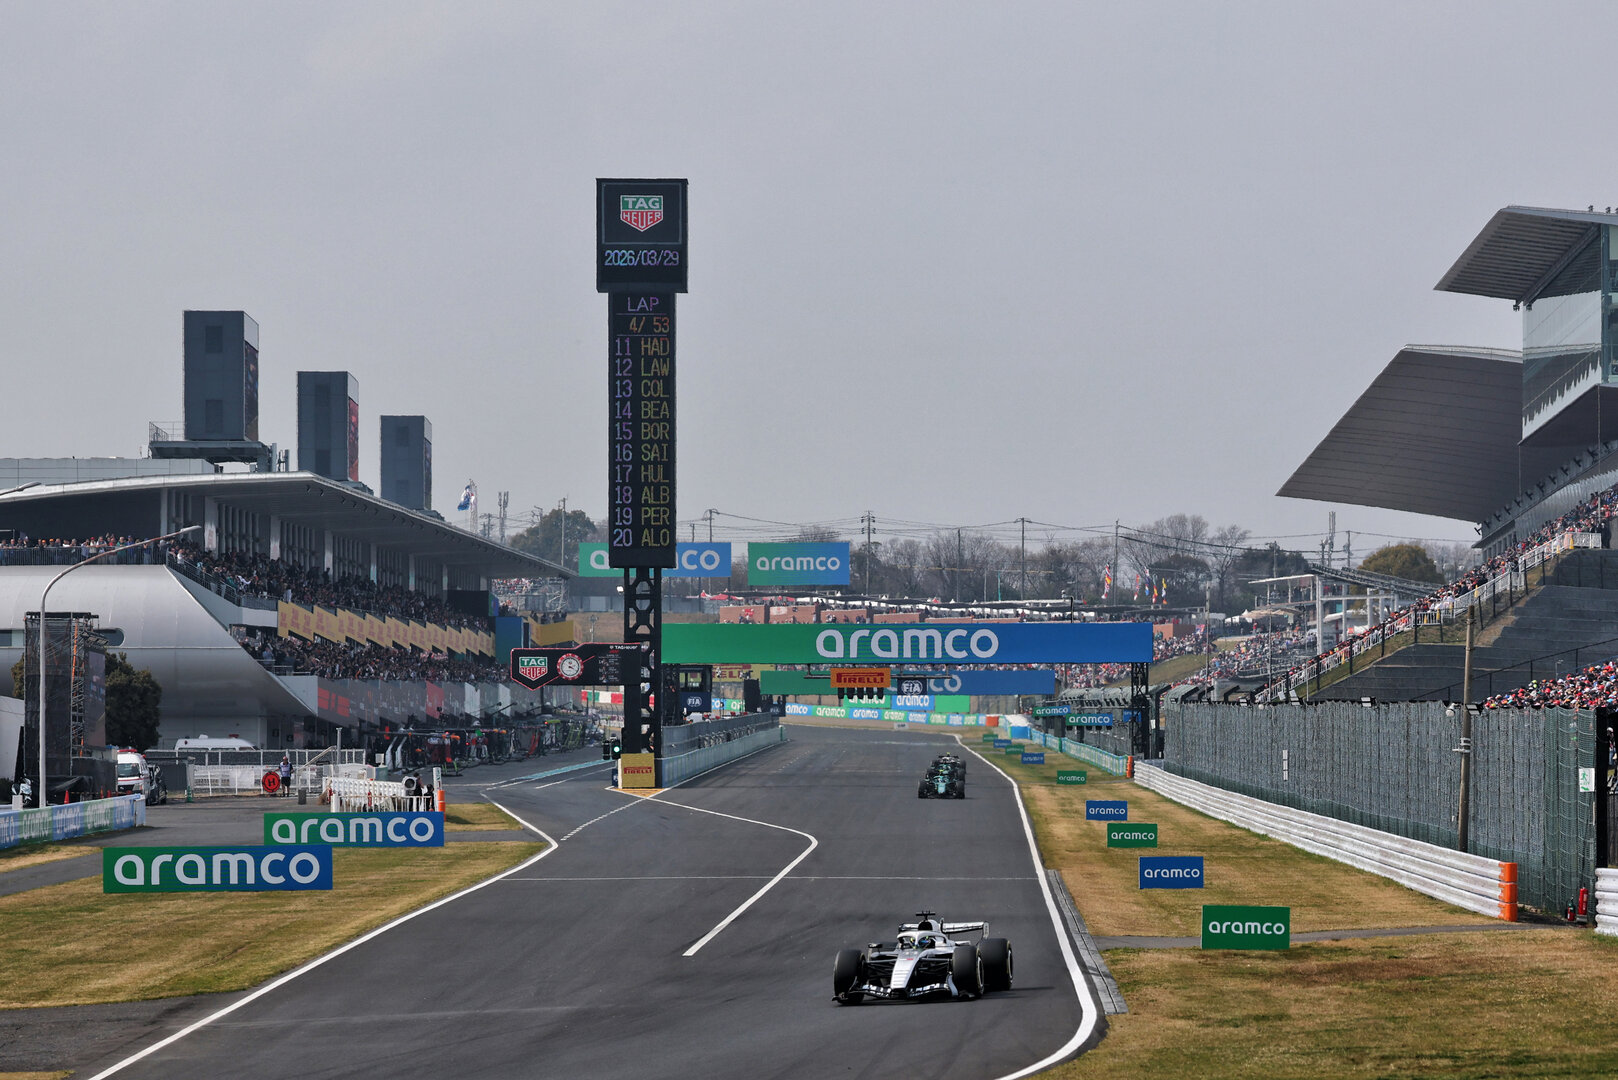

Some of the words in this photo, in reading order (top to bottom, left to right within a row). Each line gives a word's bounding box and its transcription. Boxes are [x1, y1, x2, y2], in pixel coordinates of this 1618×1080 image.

[623, 198, 660, 209] TAG
[621, 211, 662, 229] HEUER
[604, 250, 680, 266] 2026/03/29
[627, 297, 660, 312] LAP
[629, 317, 646, 333] 4/
[653, 317, 670, 333] 53
[615, 337, 631, 356] 11
[641, 337, 670, 356] HAD
[615, 358, 632, 377] 12
[641, 358, 670, 377] LAW
[615, 379, 632, 398] 13
[641, 379, 670, 398] COL
[615, 401, 632, 419] 14
[641, 401, 670, 419] BEA
[615, 422, 632, 440] 15
[641, 422, 670, 440] BOR
[615, 443, 632, 462] 16
[641, 443, 669, 462] SAI
[615, 464, 632, 483] 17
[641, 464, 670, 483] HUL
[615, 485, 632, 504] 18
[641, 485, 670, 504] ALB
[615, 507, 632, 525] 19
[641, 507, 670, 525] PER
[613, 528, 632, 547] 20
[641, 528, 670, 547] ALO
[589, 550, 720, 571] aco
[756, 556, 840, 571] aramco
[816, 628, 999, 659] aramco
[522, 658, 545, 666] TAG
[520, 667, 546, 680] HEUER
[836, 672, 884, 684] PIRELLI
[896, 695, 930, 707] aramco
[785, 705, 808, 714] amco
[816, 707, 846, 718] aramco
[1036, 707, 1069, 715] aramco
[1069, 715, 1110, 724] aramco
[1089, 806, 1126, 815] aramco
[271, 817, 434, 844] aramco
[1111, 831, 1155, 841] aramco
[113, 852, 321, 886] aramco
[1144, 867, 1201, 878] aramco
[1208, 921, 1286, 936] aramco
